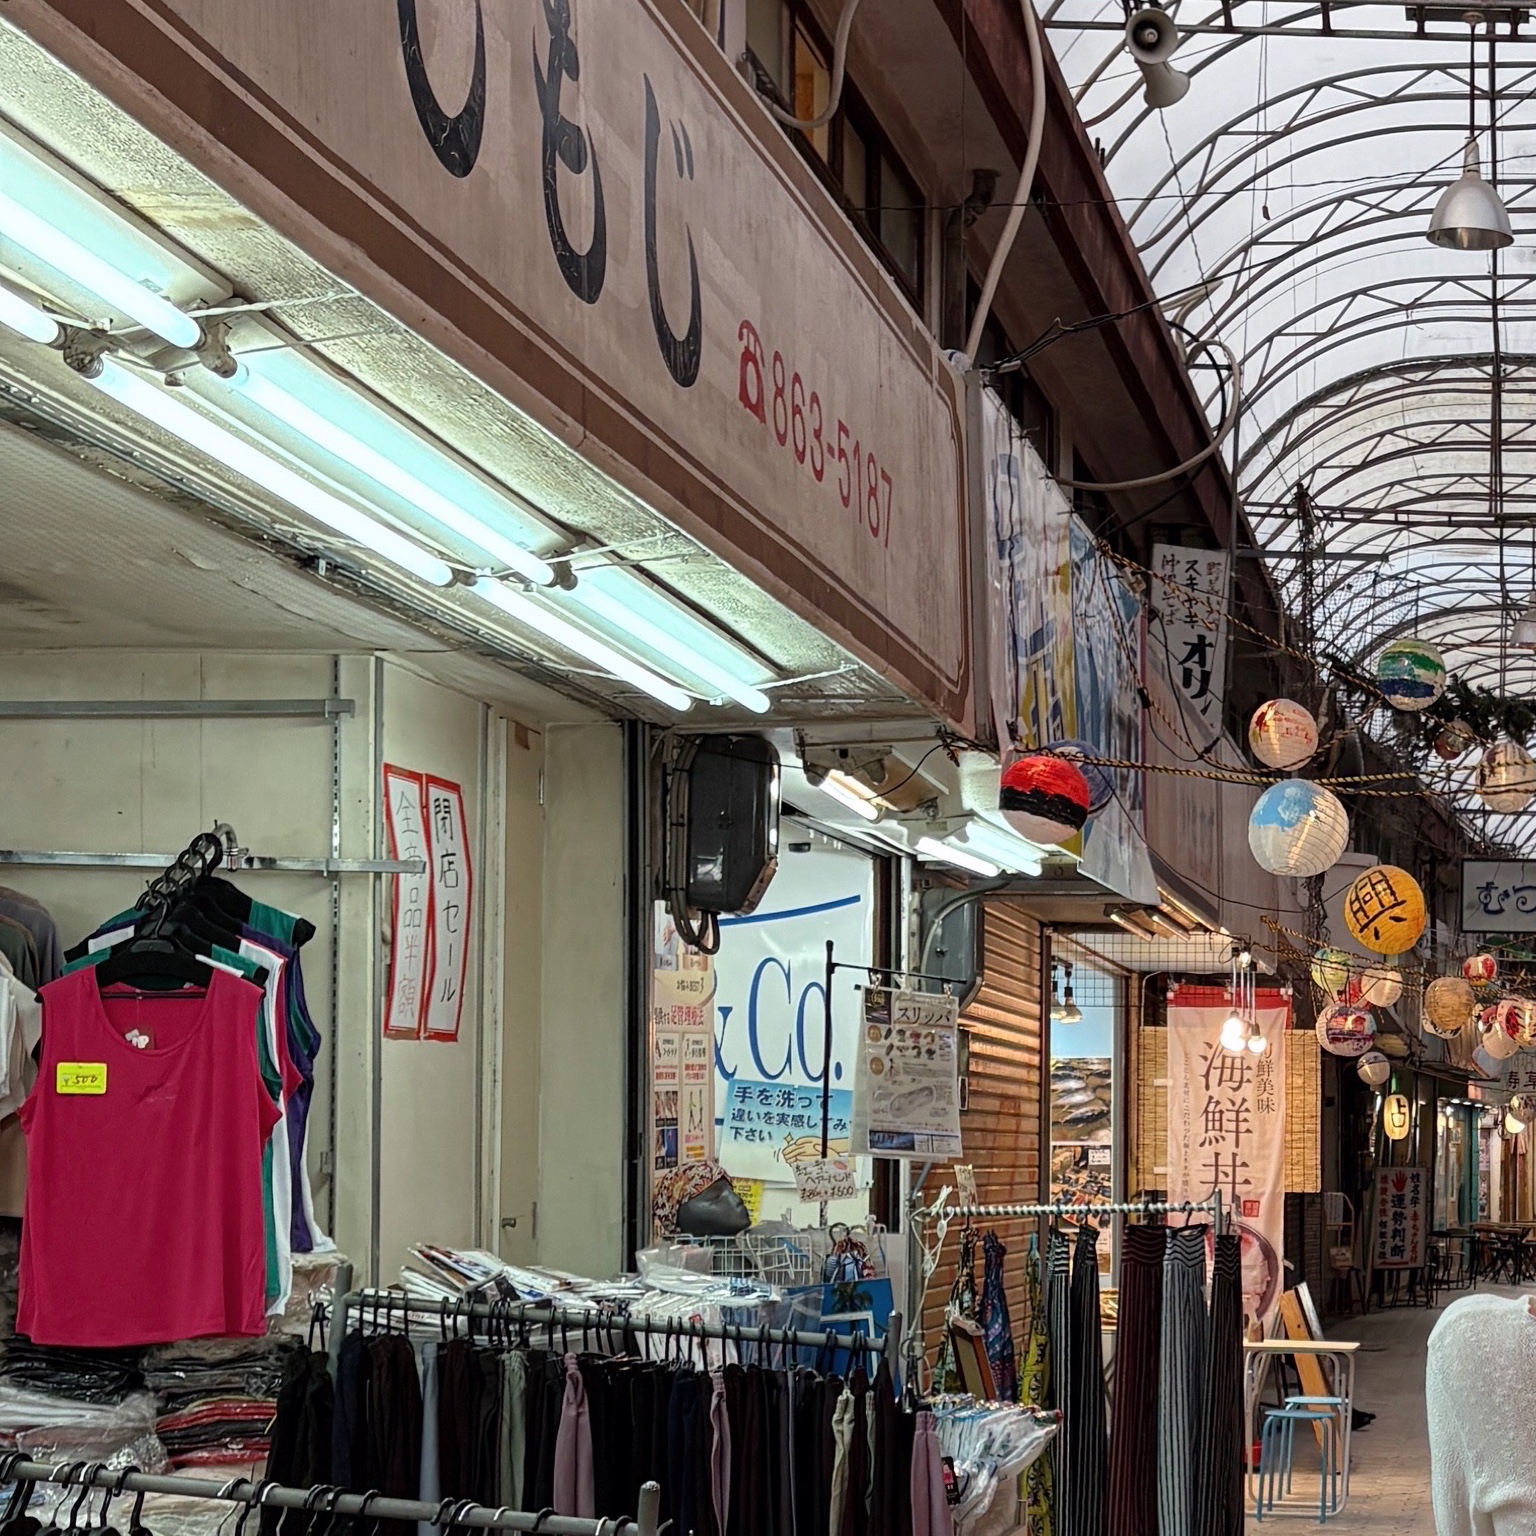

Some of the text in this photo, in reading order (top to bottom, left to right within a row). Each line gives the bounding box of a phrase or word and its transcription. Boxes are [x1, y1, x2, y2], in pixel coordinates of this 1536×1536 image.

[772, 350, 893, 550] 863-5187
[433, 797, 458, 1004] 閉店セール
[749, 957, 842, 1082] Co.
[897, 1005, 953, 1025] スリッパ
[730, 1126, 772, 1143] 下さい
[731, 1107, 851, 1132] 違いを実感しみ
[1198, 1041, 1253, 1203] 海鮮丼
[1391, 1098, 1407, 1128] 占
[1390, 1194, 1407, 1260] 運勢判断
